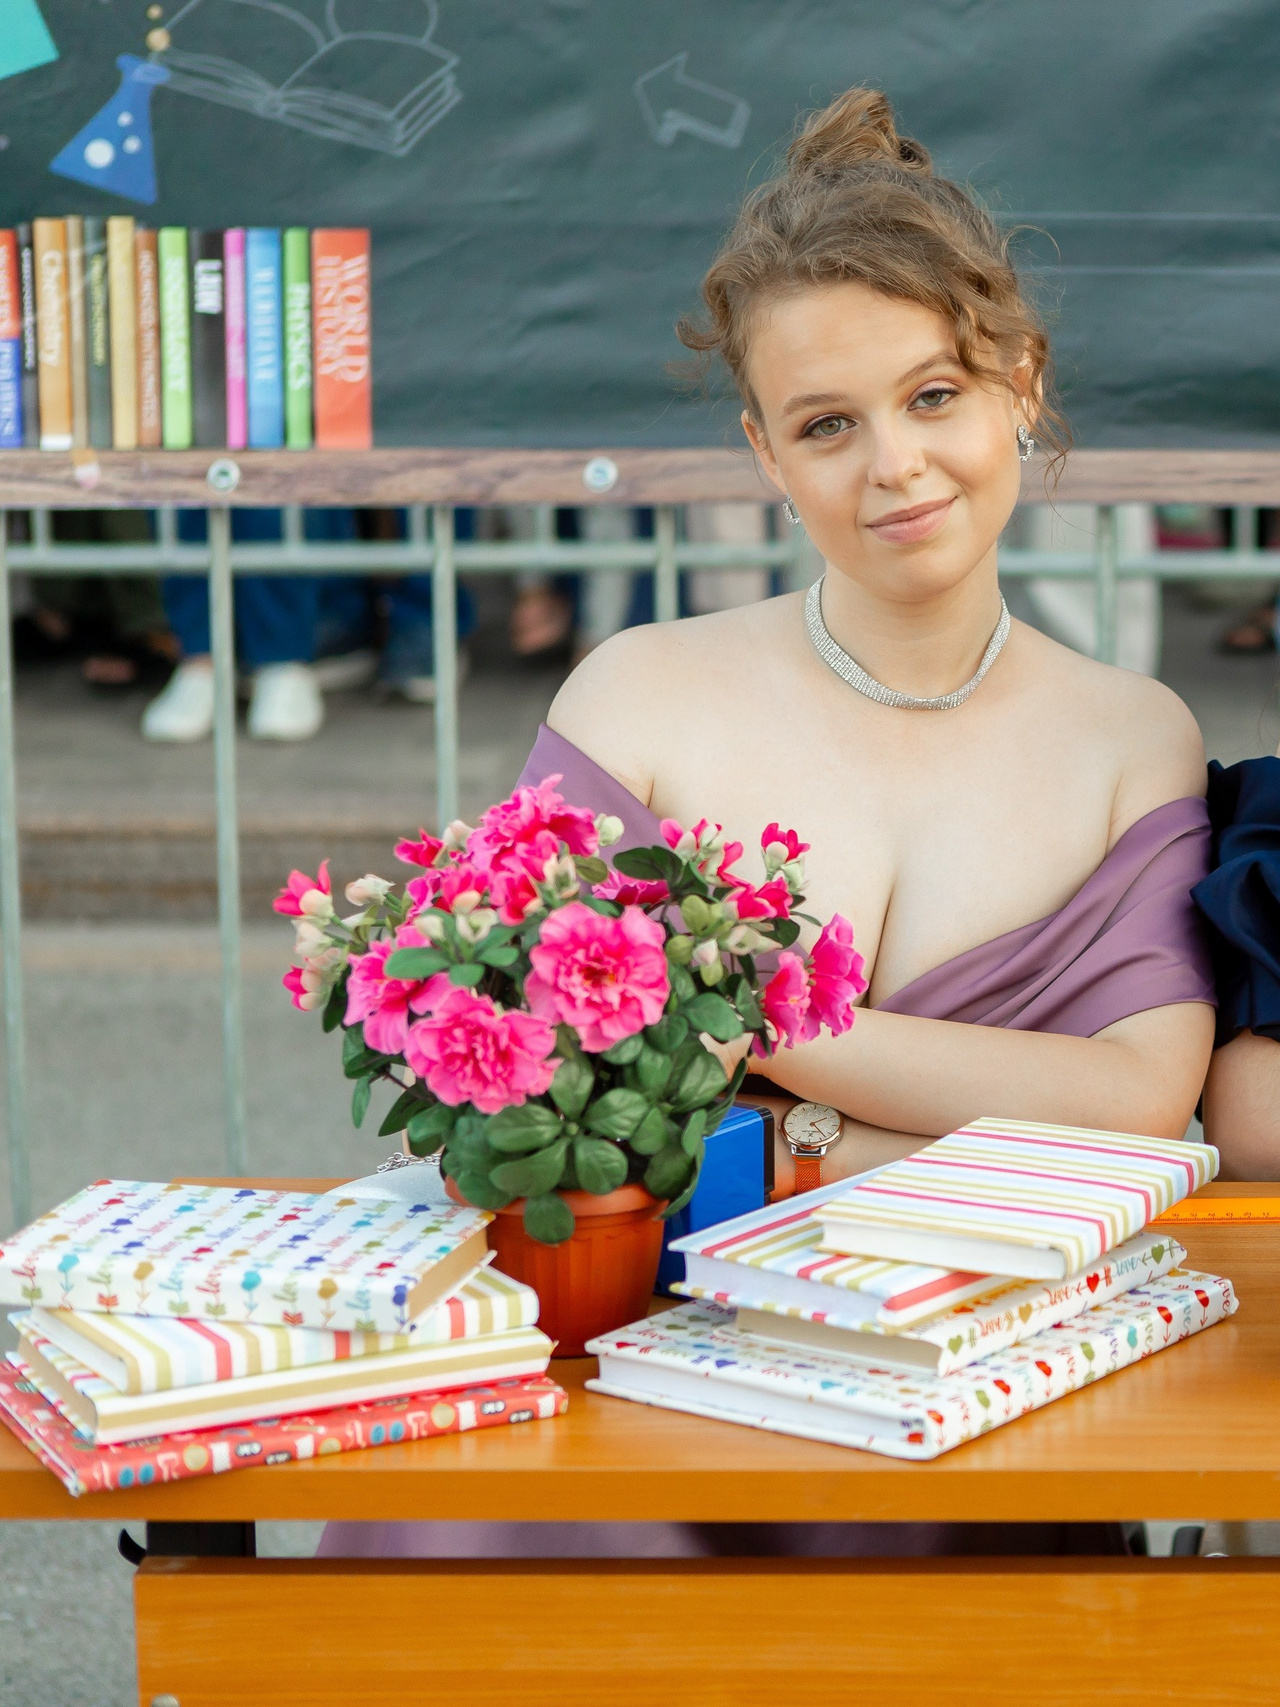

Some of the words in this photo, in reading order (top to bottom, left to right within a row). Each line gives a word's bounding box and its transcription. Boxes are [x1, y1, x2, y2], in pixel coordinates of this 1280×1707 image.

[39, 251, 63, 367] Chemistry
[286, 283, 311, 390] PHYSICS
[316, 255, 345, 378] HISTORY
[341, 254, 370, 383] WORLD
[1111, 1255, 1140, 1279] love
